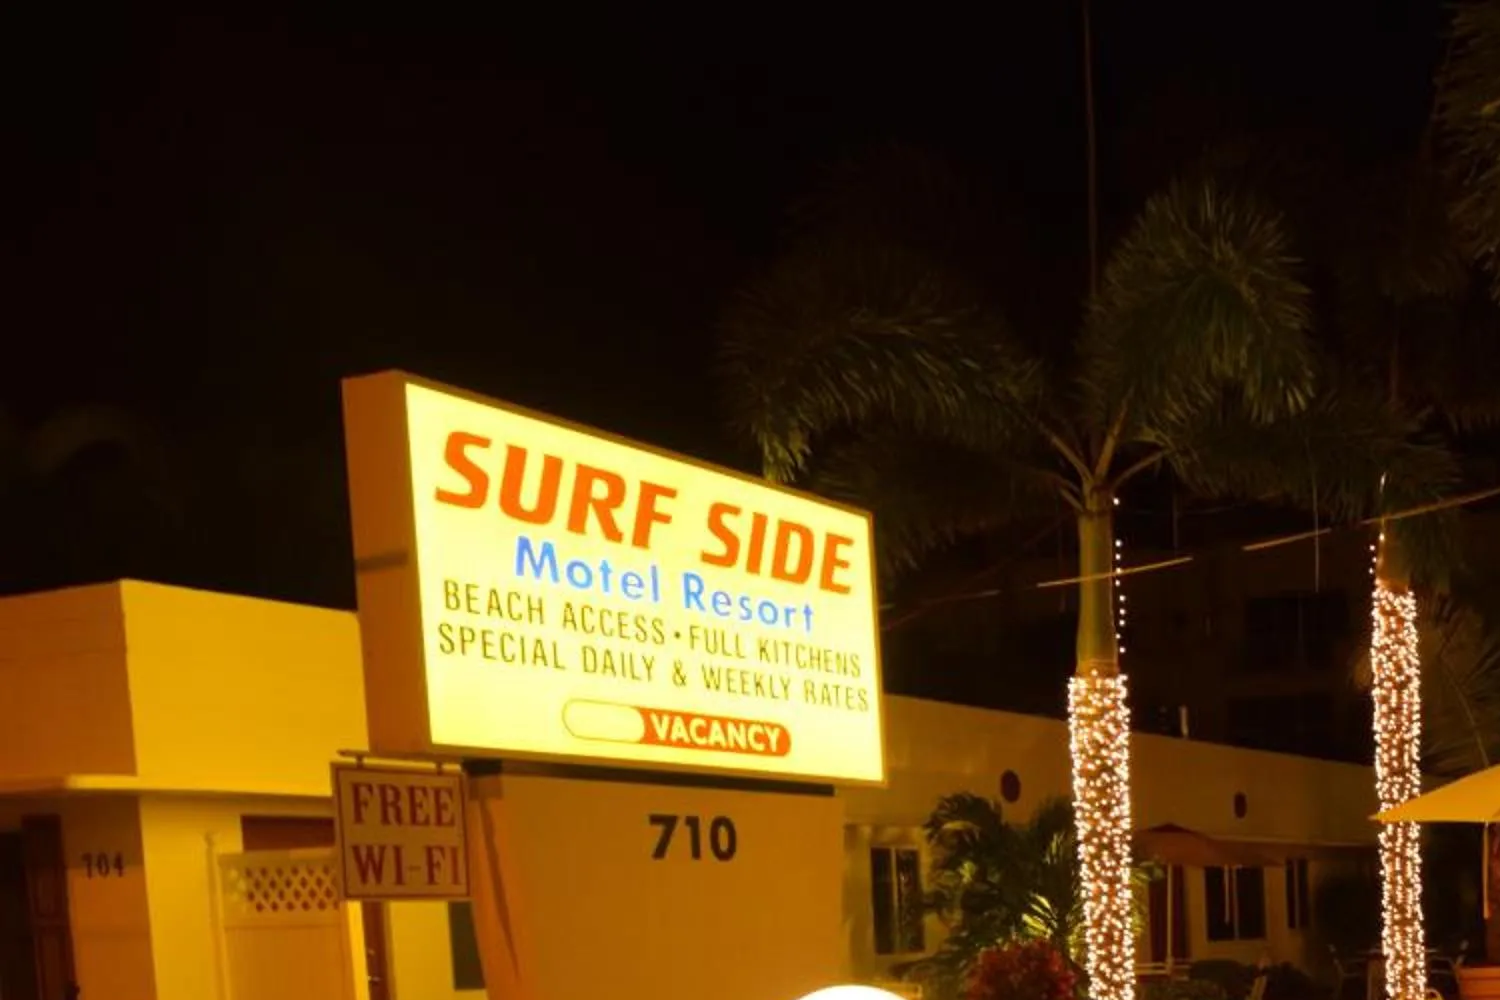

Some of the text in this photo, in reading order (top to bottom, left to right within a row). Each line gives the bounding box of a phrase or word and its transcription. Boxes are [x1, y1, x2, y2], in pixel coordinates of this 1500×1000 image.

[435, 430, 854, 594] SURF SIDE
[515, 536, 815, 633] Motel Resort
[444, 579, 861, 678] BEACH ACCESS FULL KITCHENS
[438, 622, 869, 712] SPECIAL DAILY & WEEKLY RATES
[650, 713, 784, 753] VACANCY
[351, 783, 455, 826] FREE
[649, 814, 738, 862] 710
[352, 845, 462, 886] WI-FI
